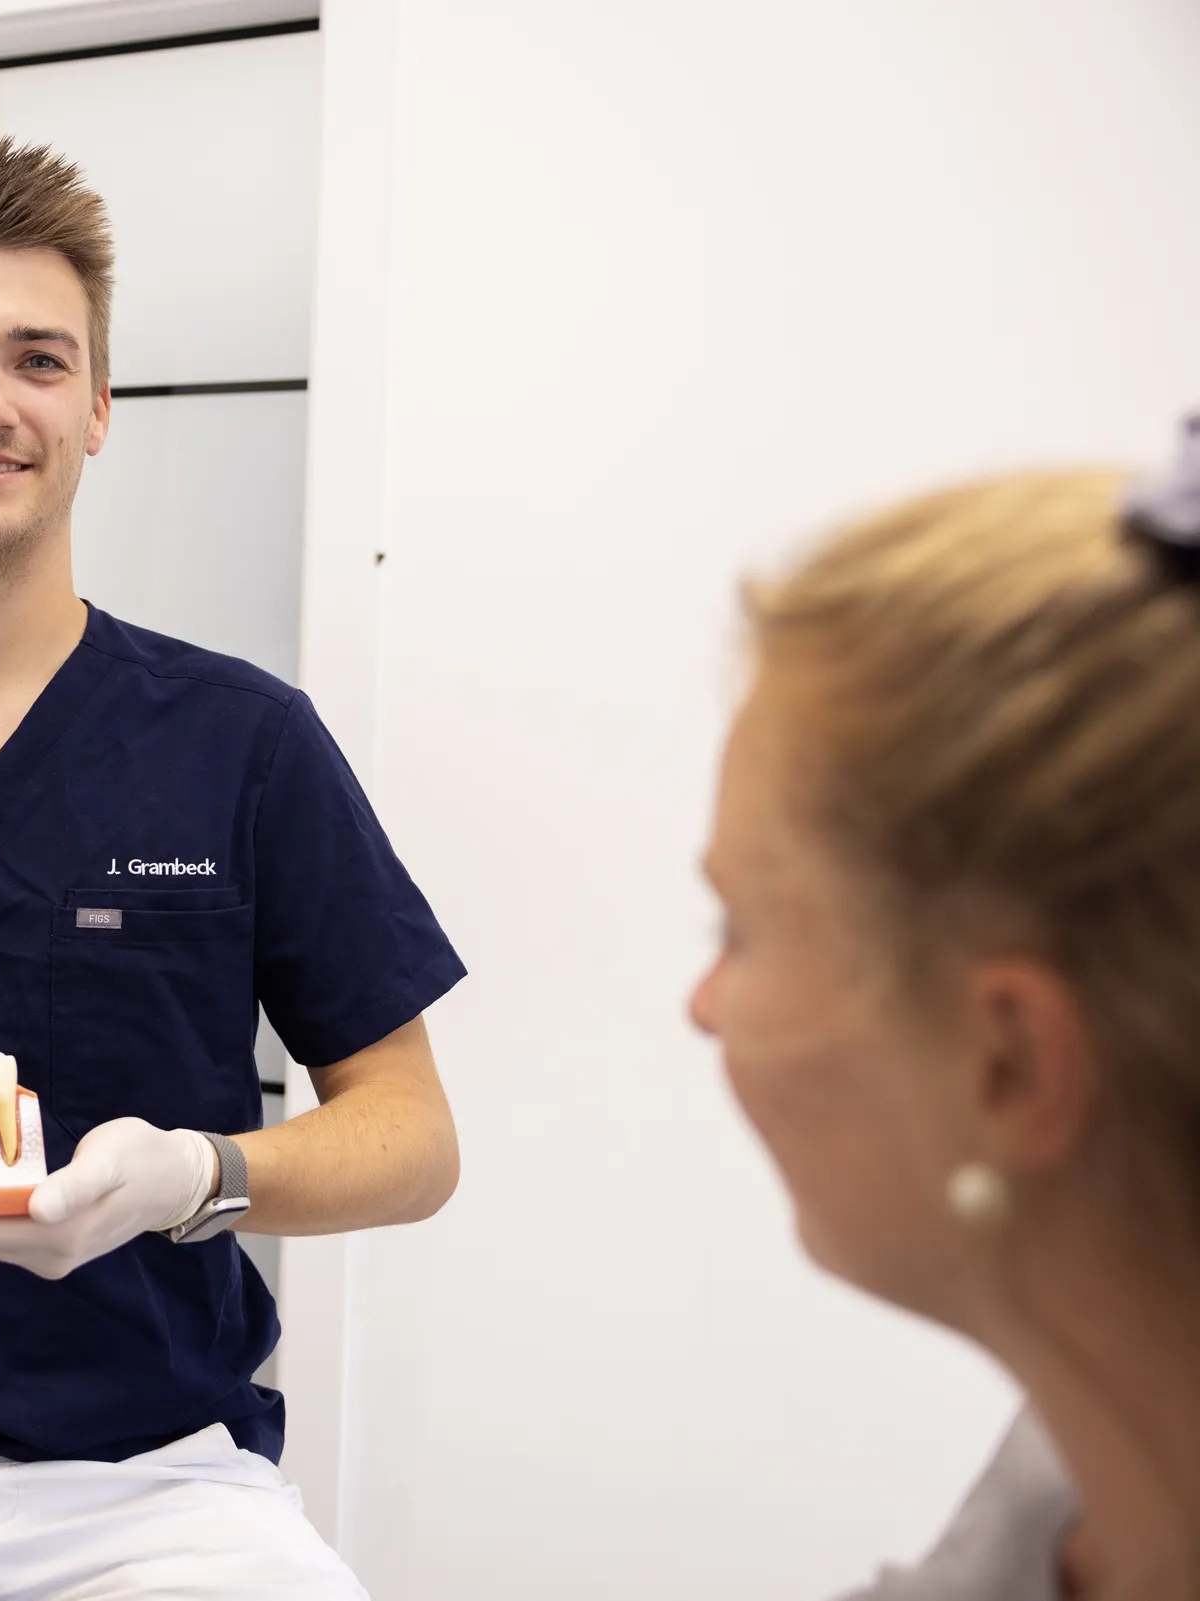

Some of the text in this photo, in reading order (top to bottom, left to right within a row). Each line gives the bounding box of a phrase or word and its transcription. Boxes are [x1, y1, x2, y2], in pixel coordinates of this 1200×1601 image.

[107, 858, 217, 876] J. Grambeck
[88, 914, 110, 924] FIGS
